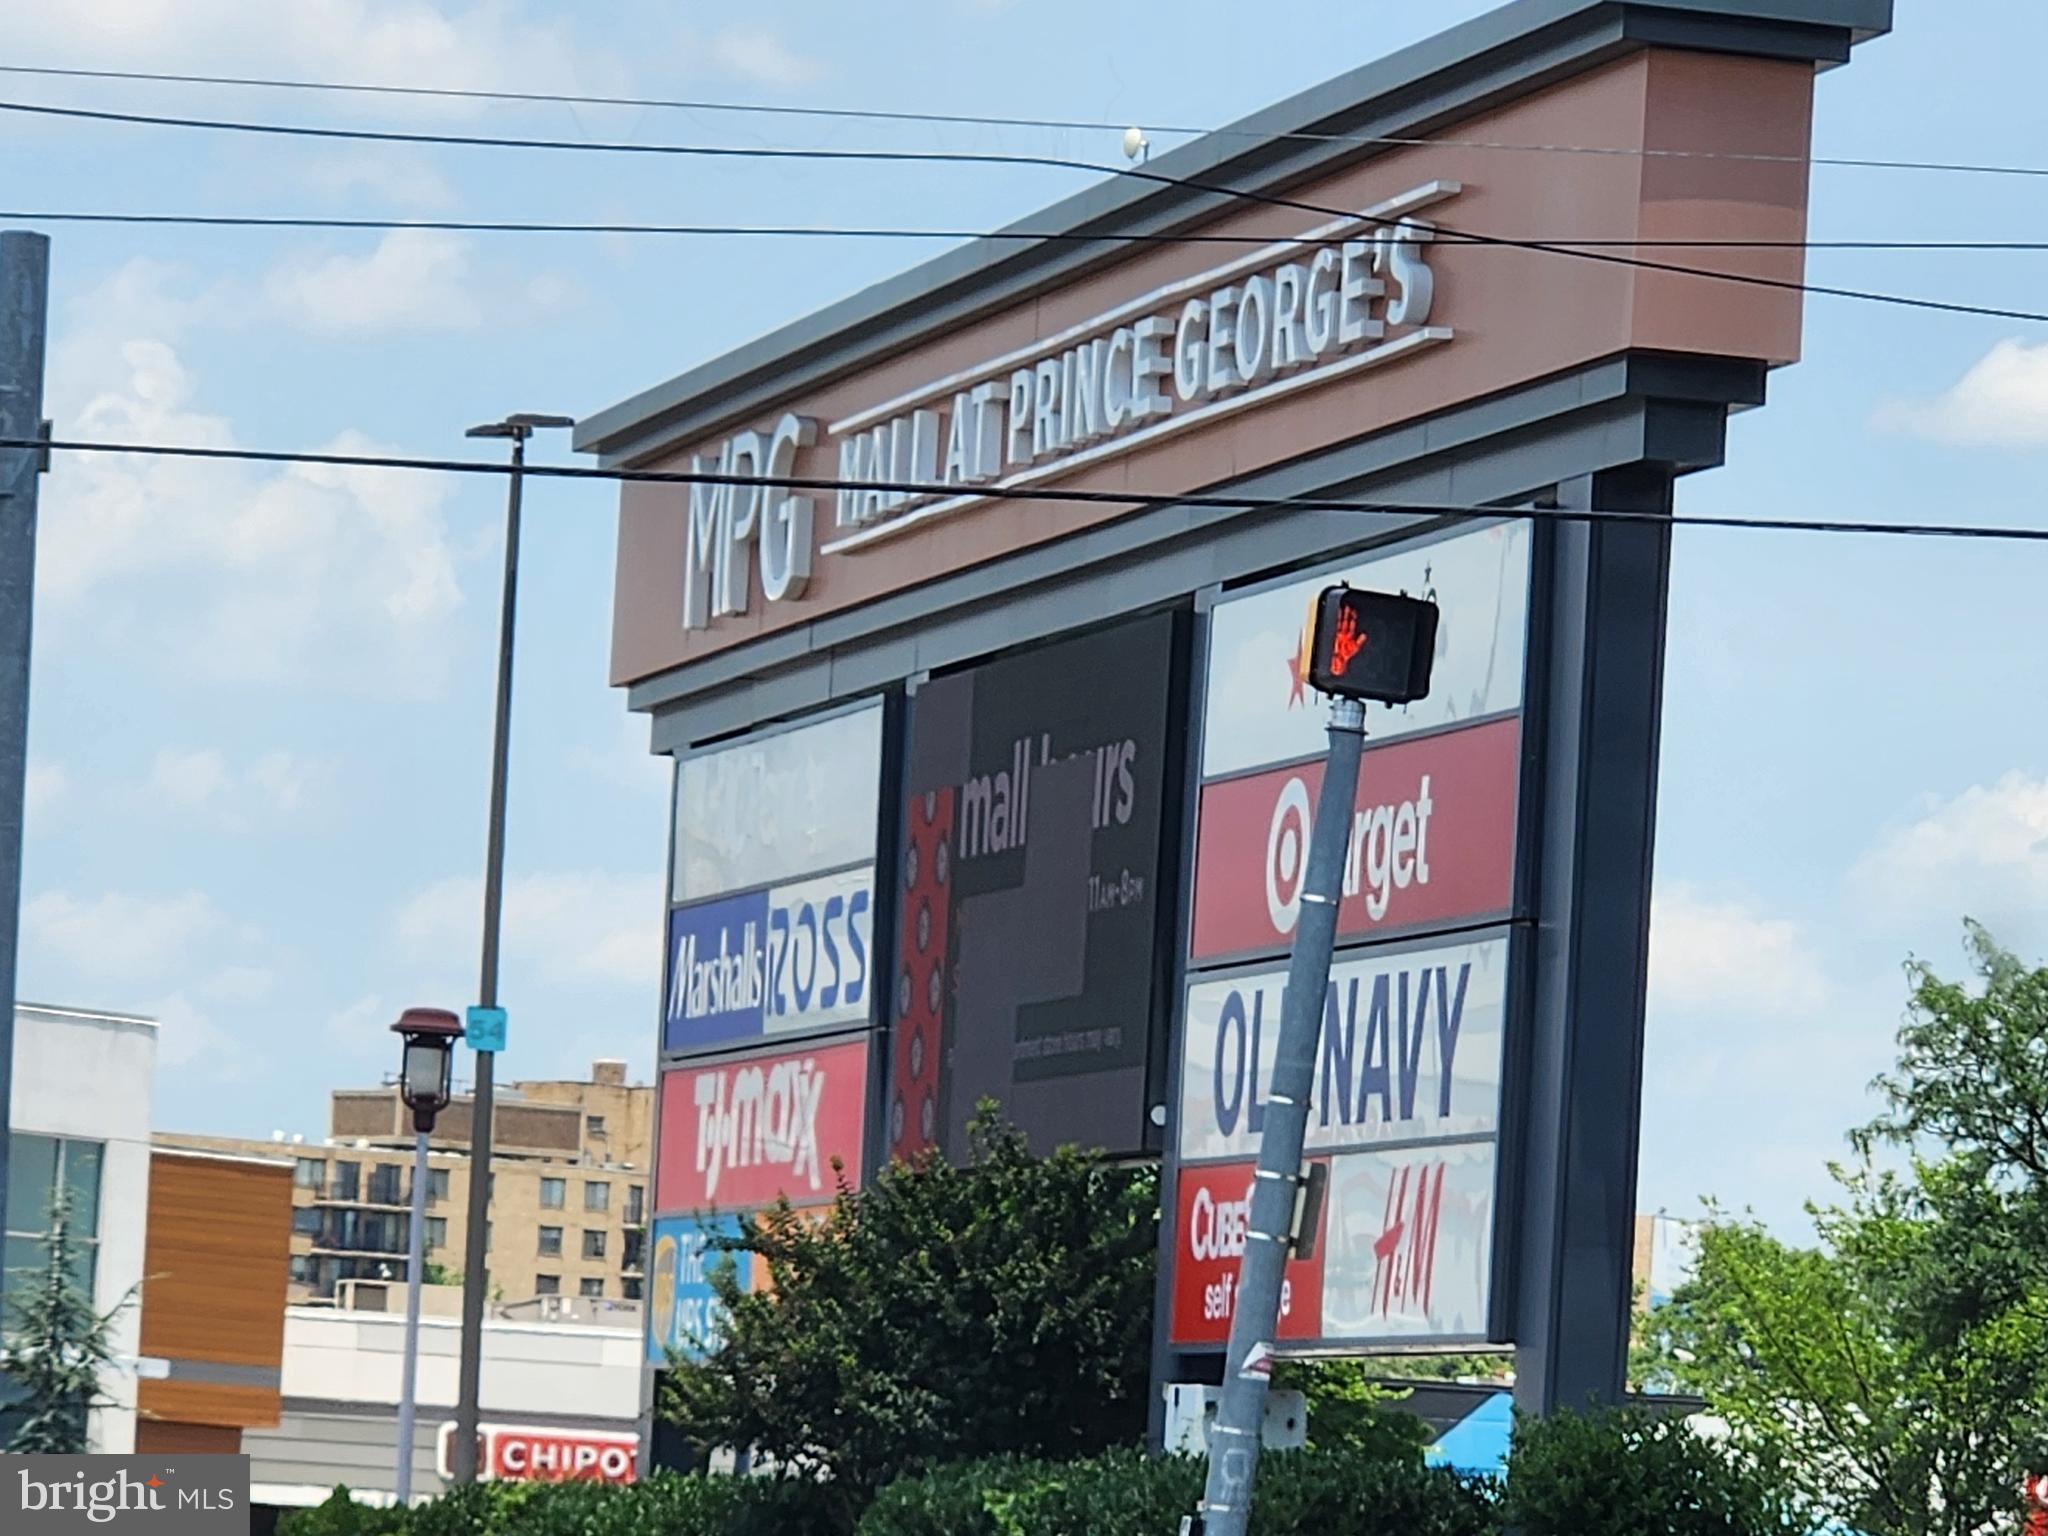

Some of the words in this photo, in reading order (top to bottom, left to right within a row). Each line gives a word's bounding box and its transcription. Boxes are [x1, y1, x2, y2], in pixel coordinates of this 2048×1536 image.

[836, 409, 949, 528] MALL
[944, 382, 1010, 492] AT
[1007, 315, 1176, 465] PRINCE
[1173, 216, 1437, 401] GEORGE'S
[682, 413, 818, 630] MPG
[959, 736, 1031, 860] mall
[667, 920, 763, 1023] Marshalls
[765, 888, 870, 1017] ROSS
[1213, 985, 1290, 1138] OL
[1320, 962, 1472, 1127] NAVY
[1204, 1272, 1233, 1320] self
[1371, 1161, 1445, 1322] H&M
